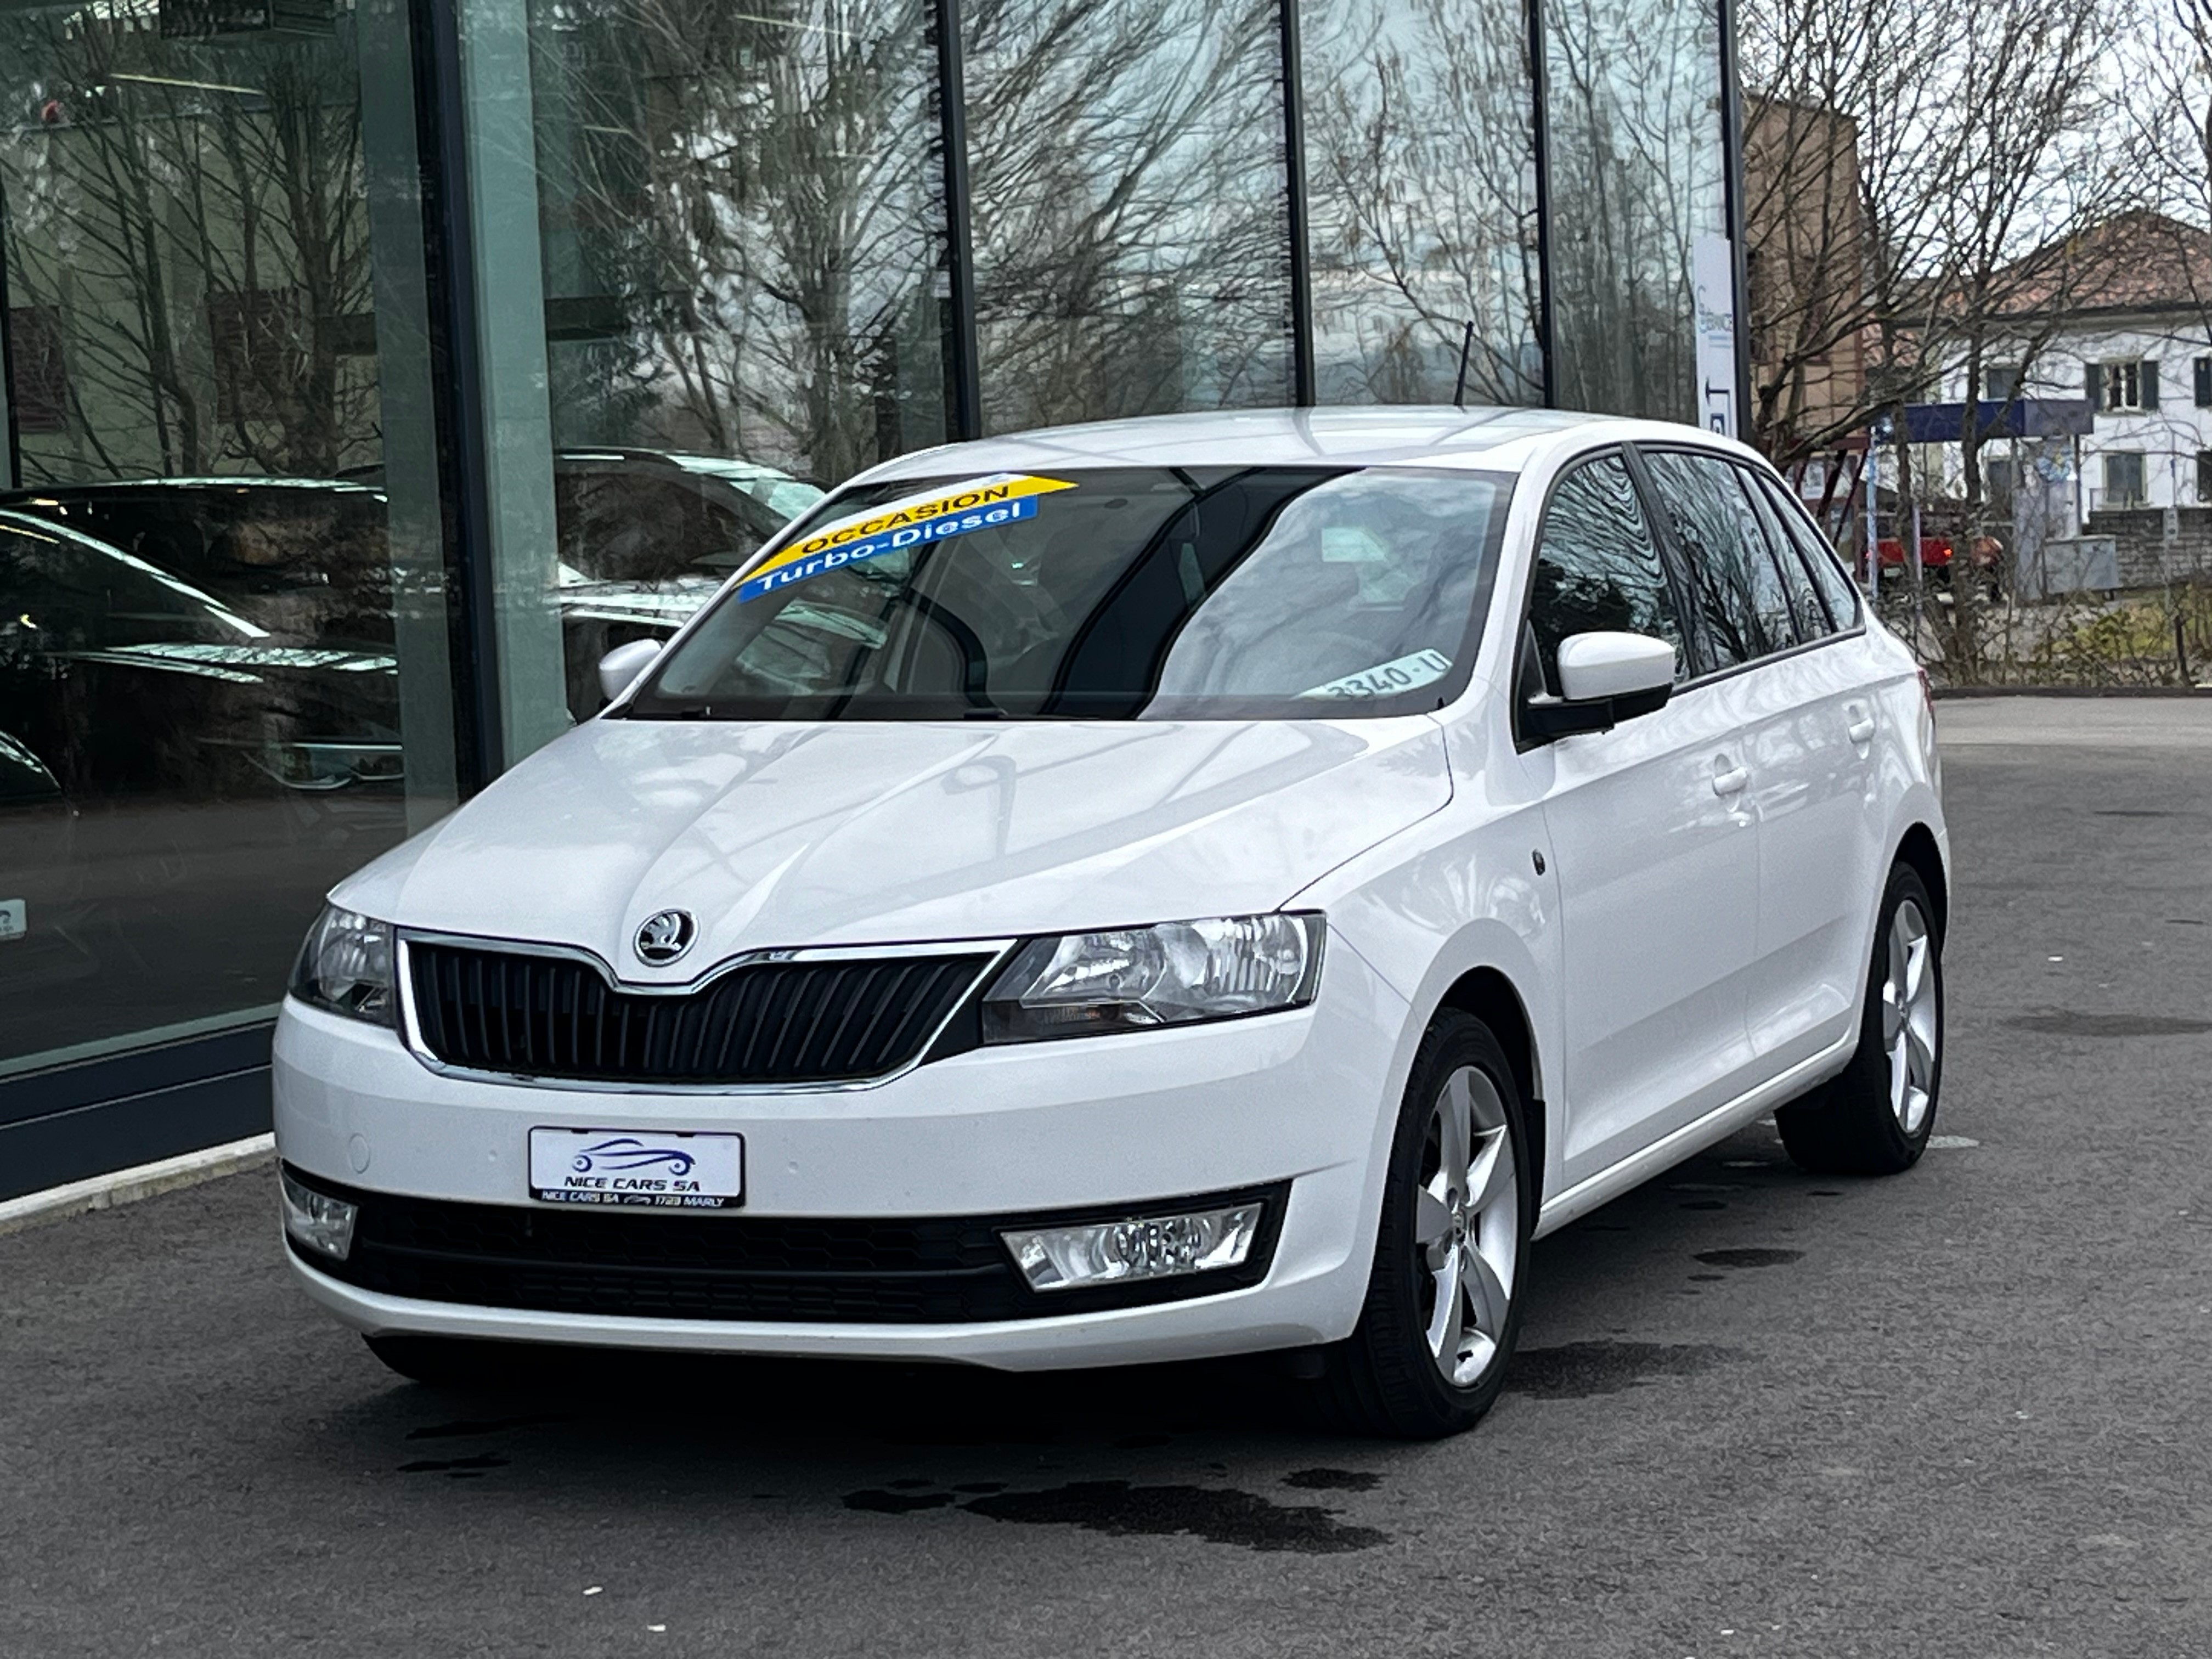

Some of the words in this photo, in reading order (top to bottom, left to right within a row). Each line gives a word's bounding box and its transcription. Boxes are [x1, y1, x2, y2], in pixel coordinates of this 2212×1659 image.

[802, 486, 1009, 554] OCCASION
[757, 501, 1020, 590] Turbo-Diesel
[542, 1190, 566, 1201] NICE
[569, 1192, 600, 1202] CARS
[602, 1193, 619, 1203] SA
[684, 1197, 725, 1207] MARLY
[565, 1176, 607, 1188] NICE
[613, 1178, 667, 1190] CARS
[673, 1180, 701, 1192] SA
